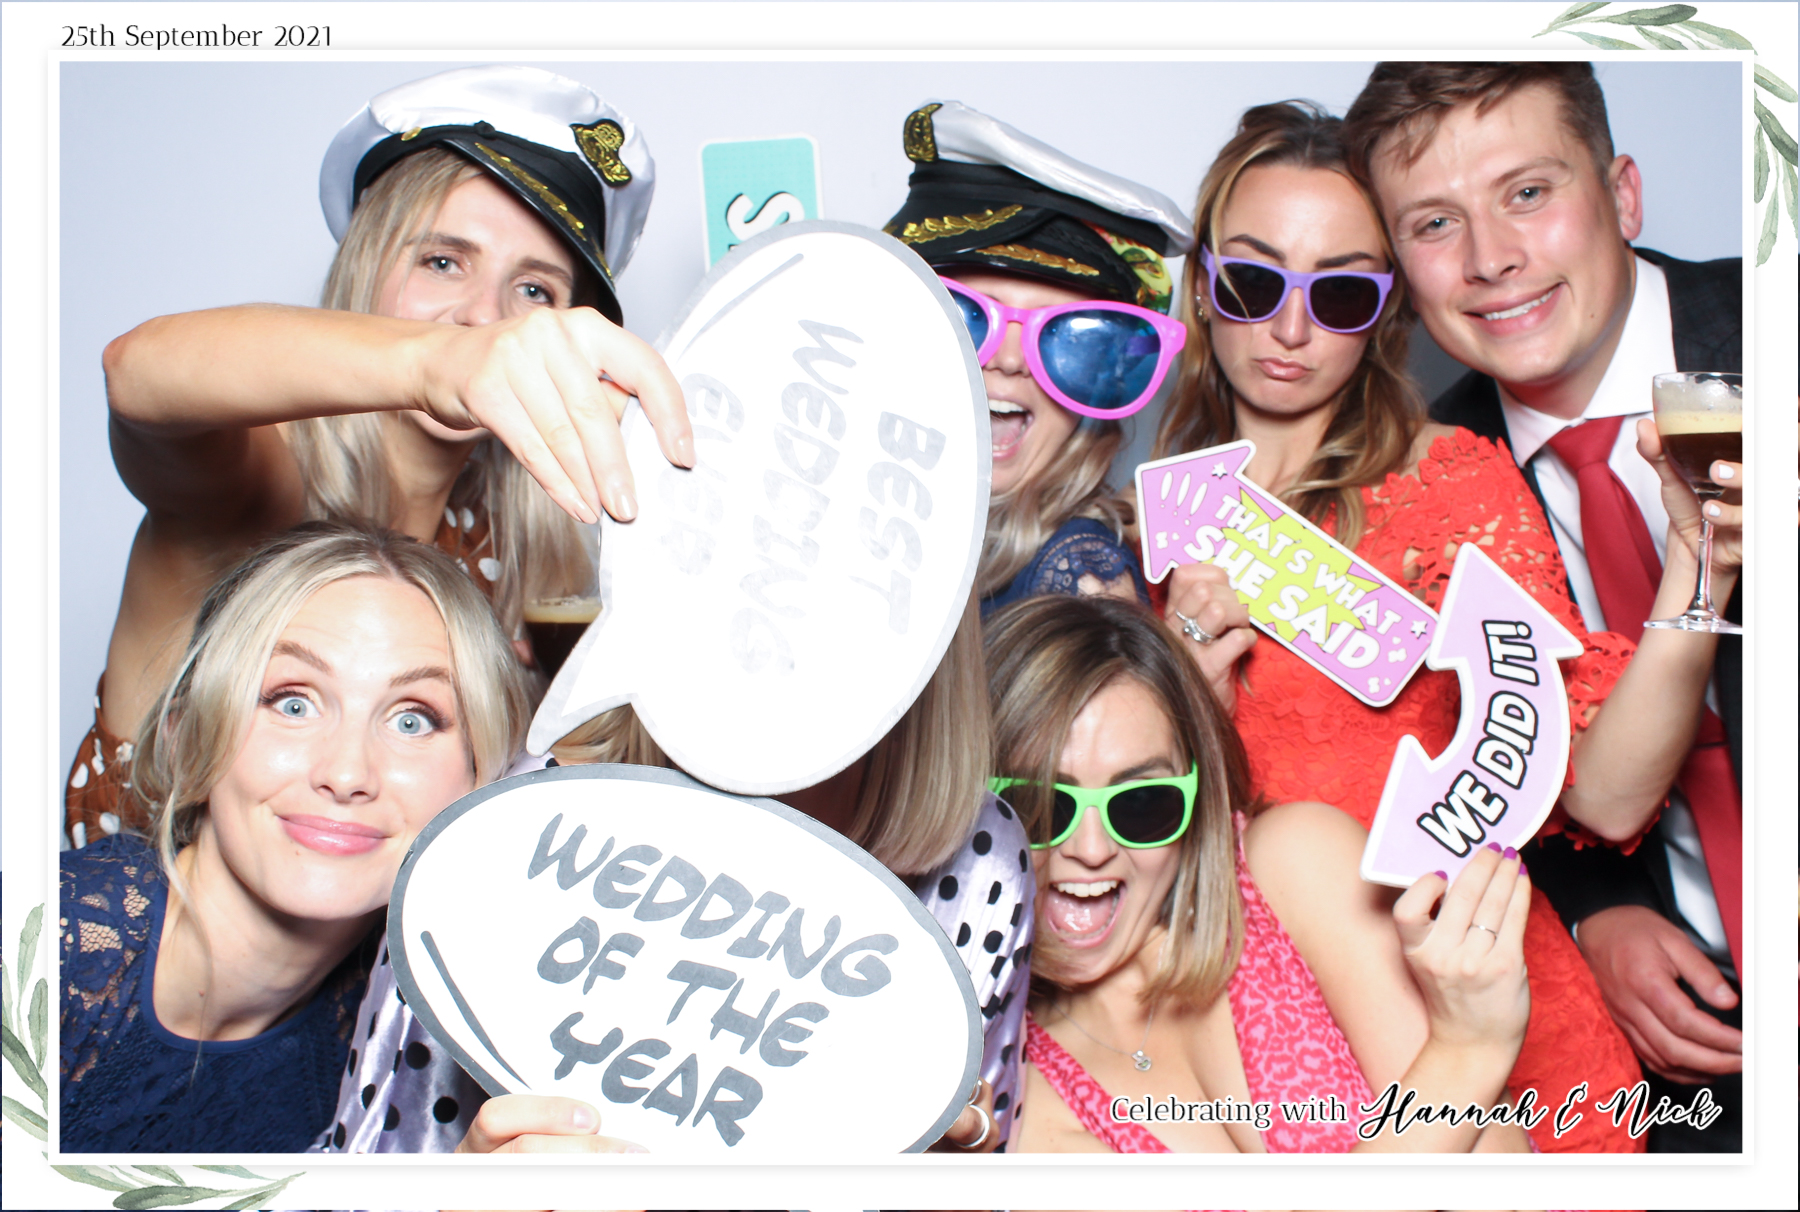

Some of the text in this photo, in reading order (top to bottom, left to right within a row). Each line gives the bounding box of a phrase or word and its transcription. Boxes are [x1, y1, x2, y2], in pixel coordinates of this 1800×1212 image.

[729, 319, 865, 677] WEDDING
[847, 411, 947, 636] BEST
[1183, 525, 1381, 669] SHE SAID
[1313, 563, 1402, 636] WHAT
[1416, 619, 1540, 858] WE DID IT!
[527, 812, 899, 998] WEDDING
[536, 916, 830, 1068] OF THE
[549, 1011, 764, 1148] YEAR
